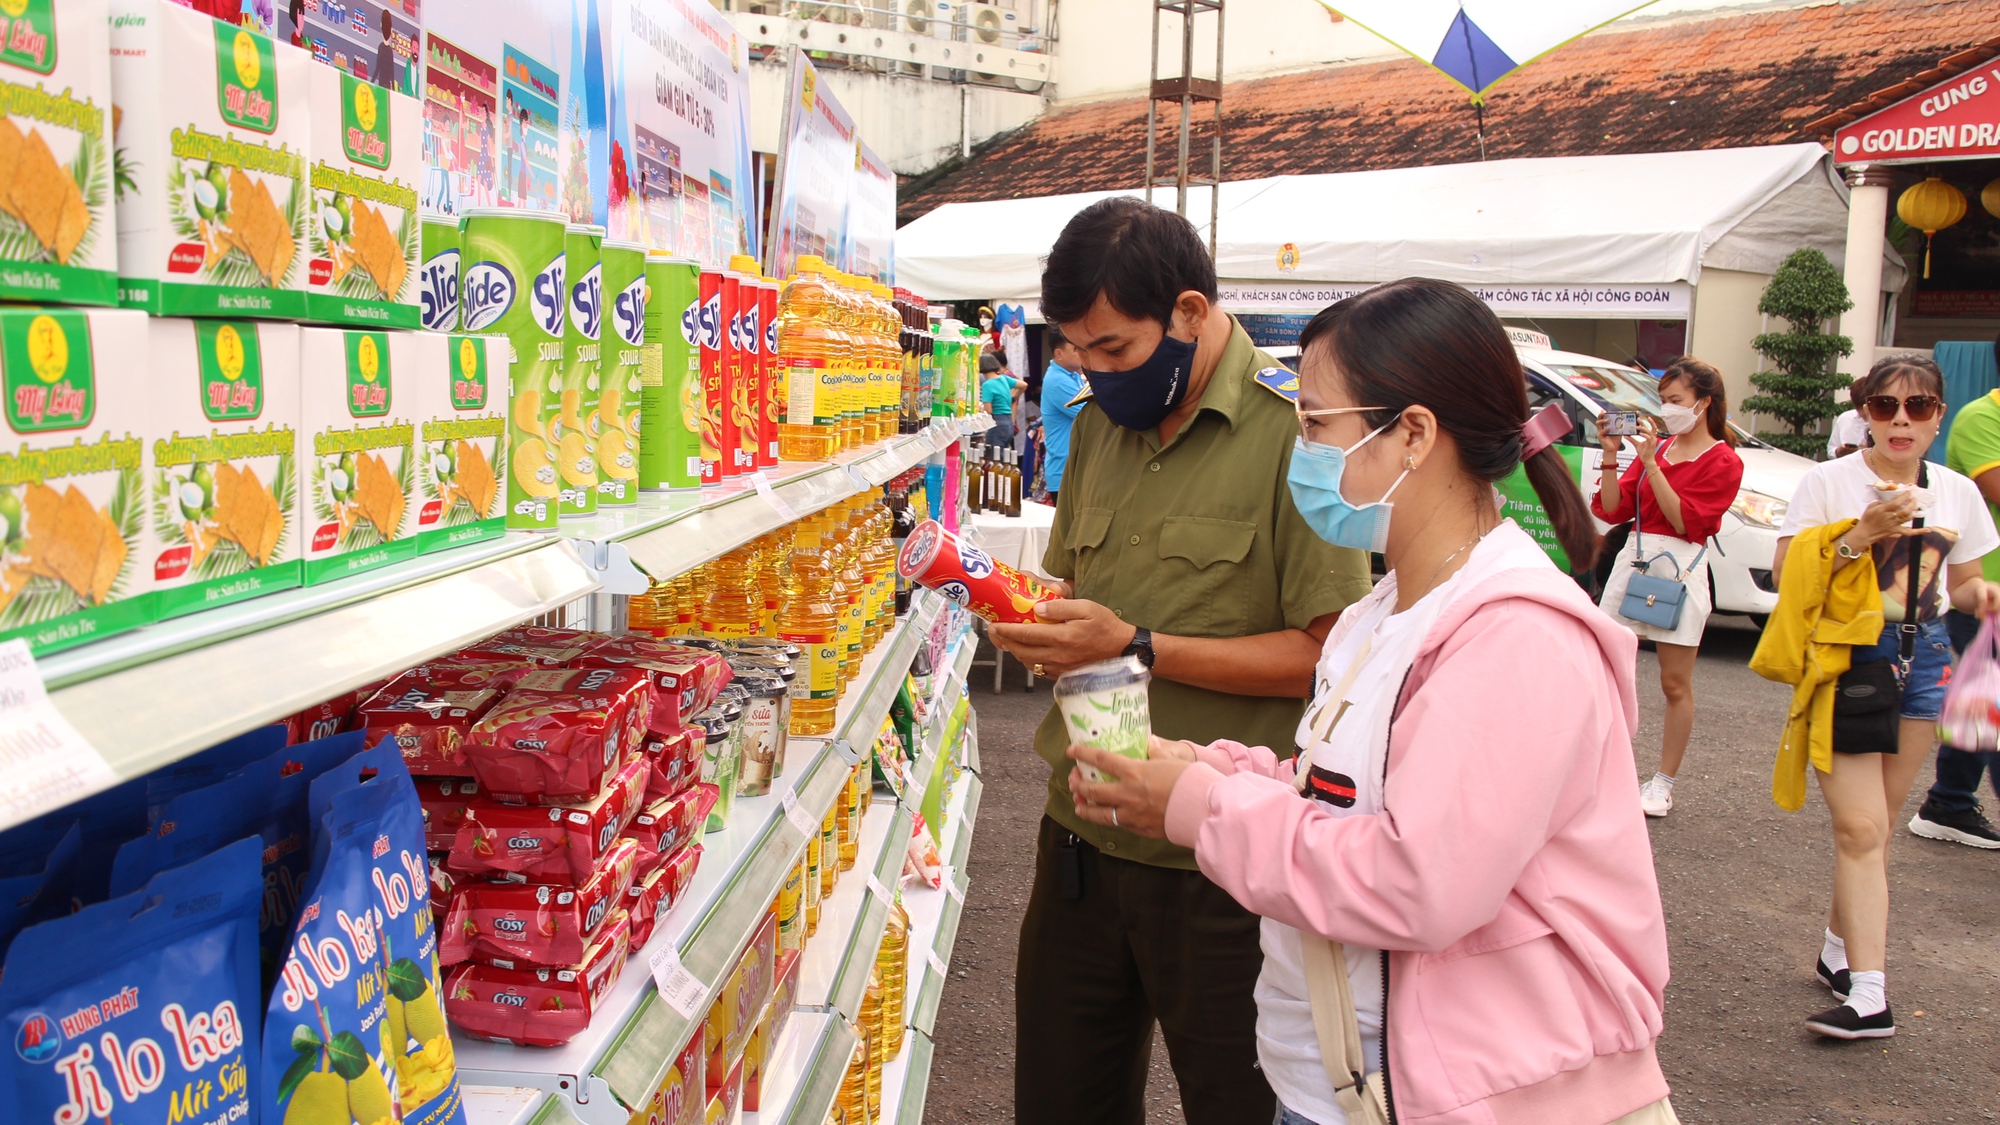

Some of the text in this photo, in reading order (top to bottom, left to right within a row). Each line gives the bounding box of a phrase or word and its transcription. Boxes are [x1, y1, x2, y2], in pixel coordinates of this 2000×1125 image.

[631, 3, 648, 43] ĐIỂM
[648, 14, 662, 54] BÁN
[662, 26, 680, 67] HÀNG
[680, 42, 694, 78] PHÚC
[695, 55, 704, 91] LỢI
[704, 62, 717, 97] ĐOÀN
[717, 73, 728, 104] VIÊN
[656, 65, 715, 139] GIẢM GIÁ TỪ 5 30%
[1920, 76, 1988, 117] CUNG
[1862, 126, 1956, 153] GOLDEN
[534, 267, 565, 330] Sli
[572, 276, 601, 334] Sli
[1241, 288, 1269, 301] KHÁCH
[1271, 291, 1288, 303] SẠN
[1289, 289, 1315, 301] CÔNG
[1317, 288, 1342, 301] ĐOÀN
[1473, 288, 1670, 305] TÂM CÔNG TÁC XÃ HỘI CÔNG ĐOÀN
[615, 287, 644, 340] Sli
[700, 302, 721, 346] Sli
[538, 342, 561, 361] SOUR
[577, 344, 598, 362] SOUR
[619, 349, 639, 366] SOUR
[230, 378, 257, 413] Lồng
[1509, 500, 1533, 513] Tiêm
[1524, 515, 1550, 525] đủ liều
[1538, 527, 1556, 538] yêu
[911, 534, 933, 562] Slide
[579, 670, 617, 690] COSY
[752, 705, 771, 720] sữa
[514, 738, 548, 750] COSY
[507, 837, 542, 849] COSY
[600, 813, 620, 853] COSY
[372, 867, 409, 919] lo
[493, 918, 527, 931] COSY
[585, 894, 609, 933] COSY
[282, 945, 318, 1010] Ji
[300, 932, 350, 989] lo
[100, 987, 139, 1022] PHÁT
[493, 993, 527, 1007] COSY
[54, 1000, 243, 1125] Ji lo ka
[167, 1054, 247, 1125] Mít Sấy
